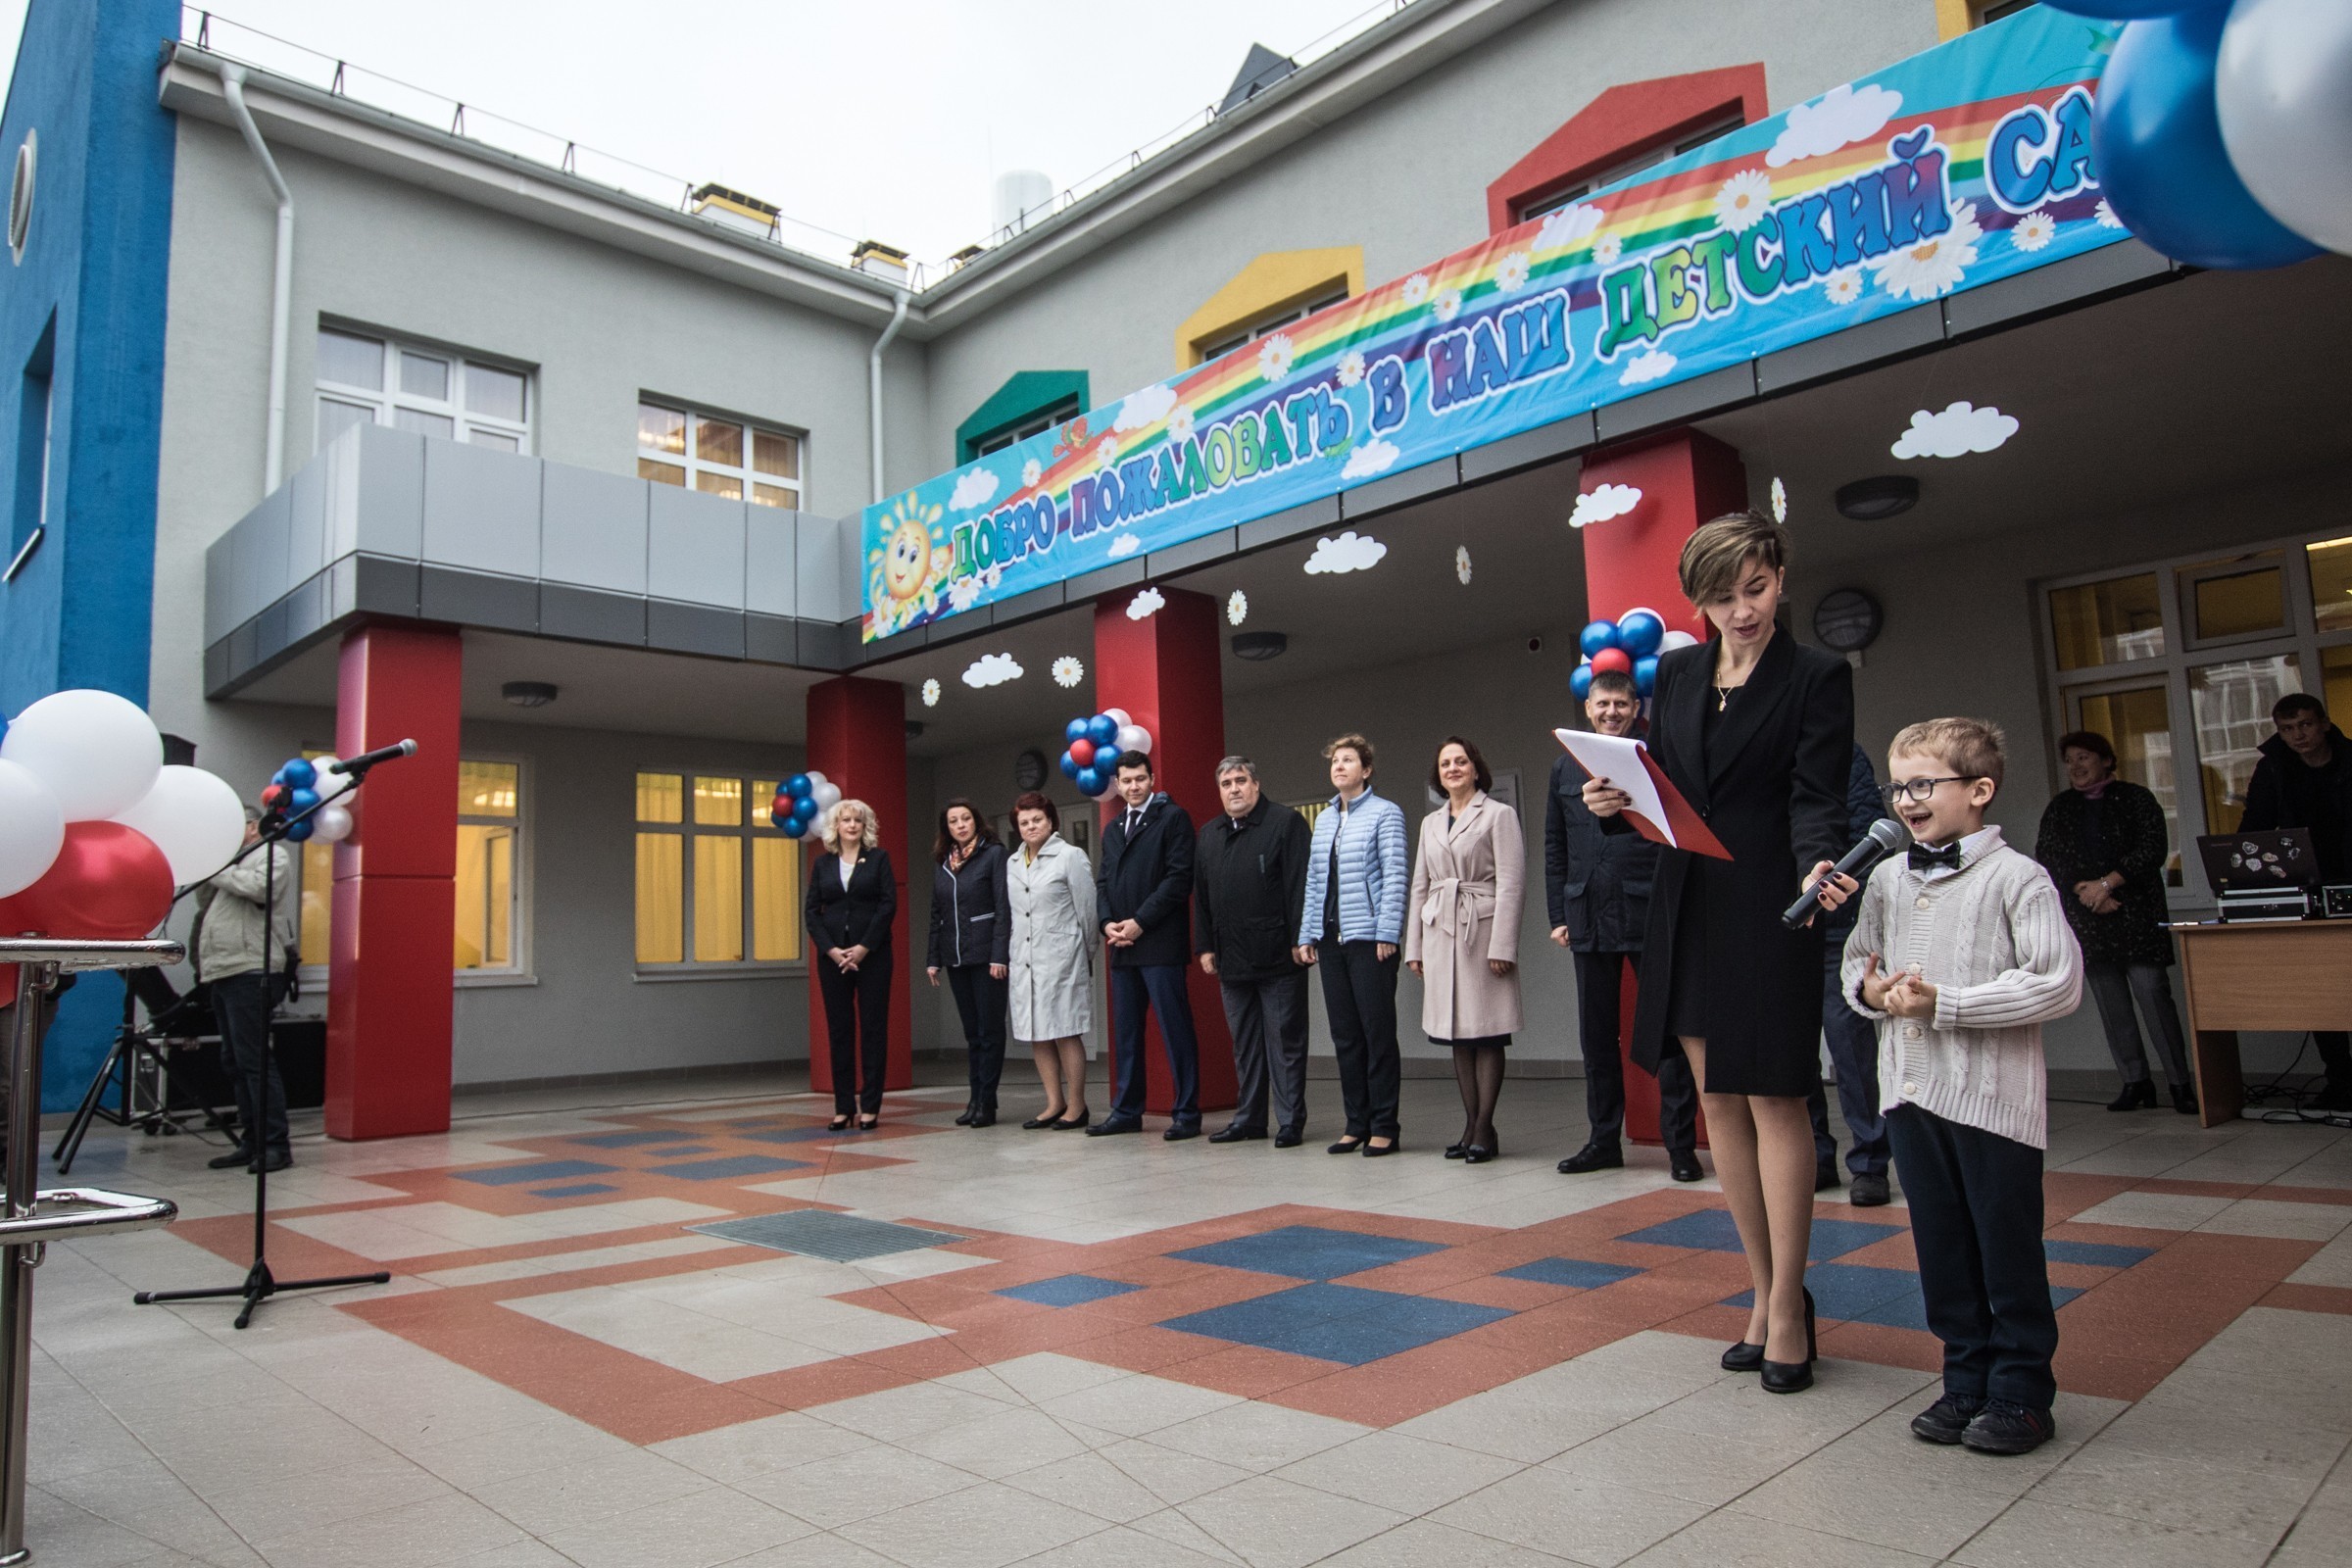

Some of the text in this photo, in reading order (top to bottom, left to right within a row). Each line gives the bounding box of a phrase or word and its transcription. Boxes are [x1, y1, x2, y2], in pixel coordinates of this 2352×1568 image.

[950, 493, 1056, 586] ДОБРО
[1070, 385, 1350, 537] ПОЖАЛОВАТЬ
[1368, 359, 1408, 432] В
[1427, 293, 1571, 412] НАШ
[1599, 127, 1953, 359] ДЕТСКИЙ
